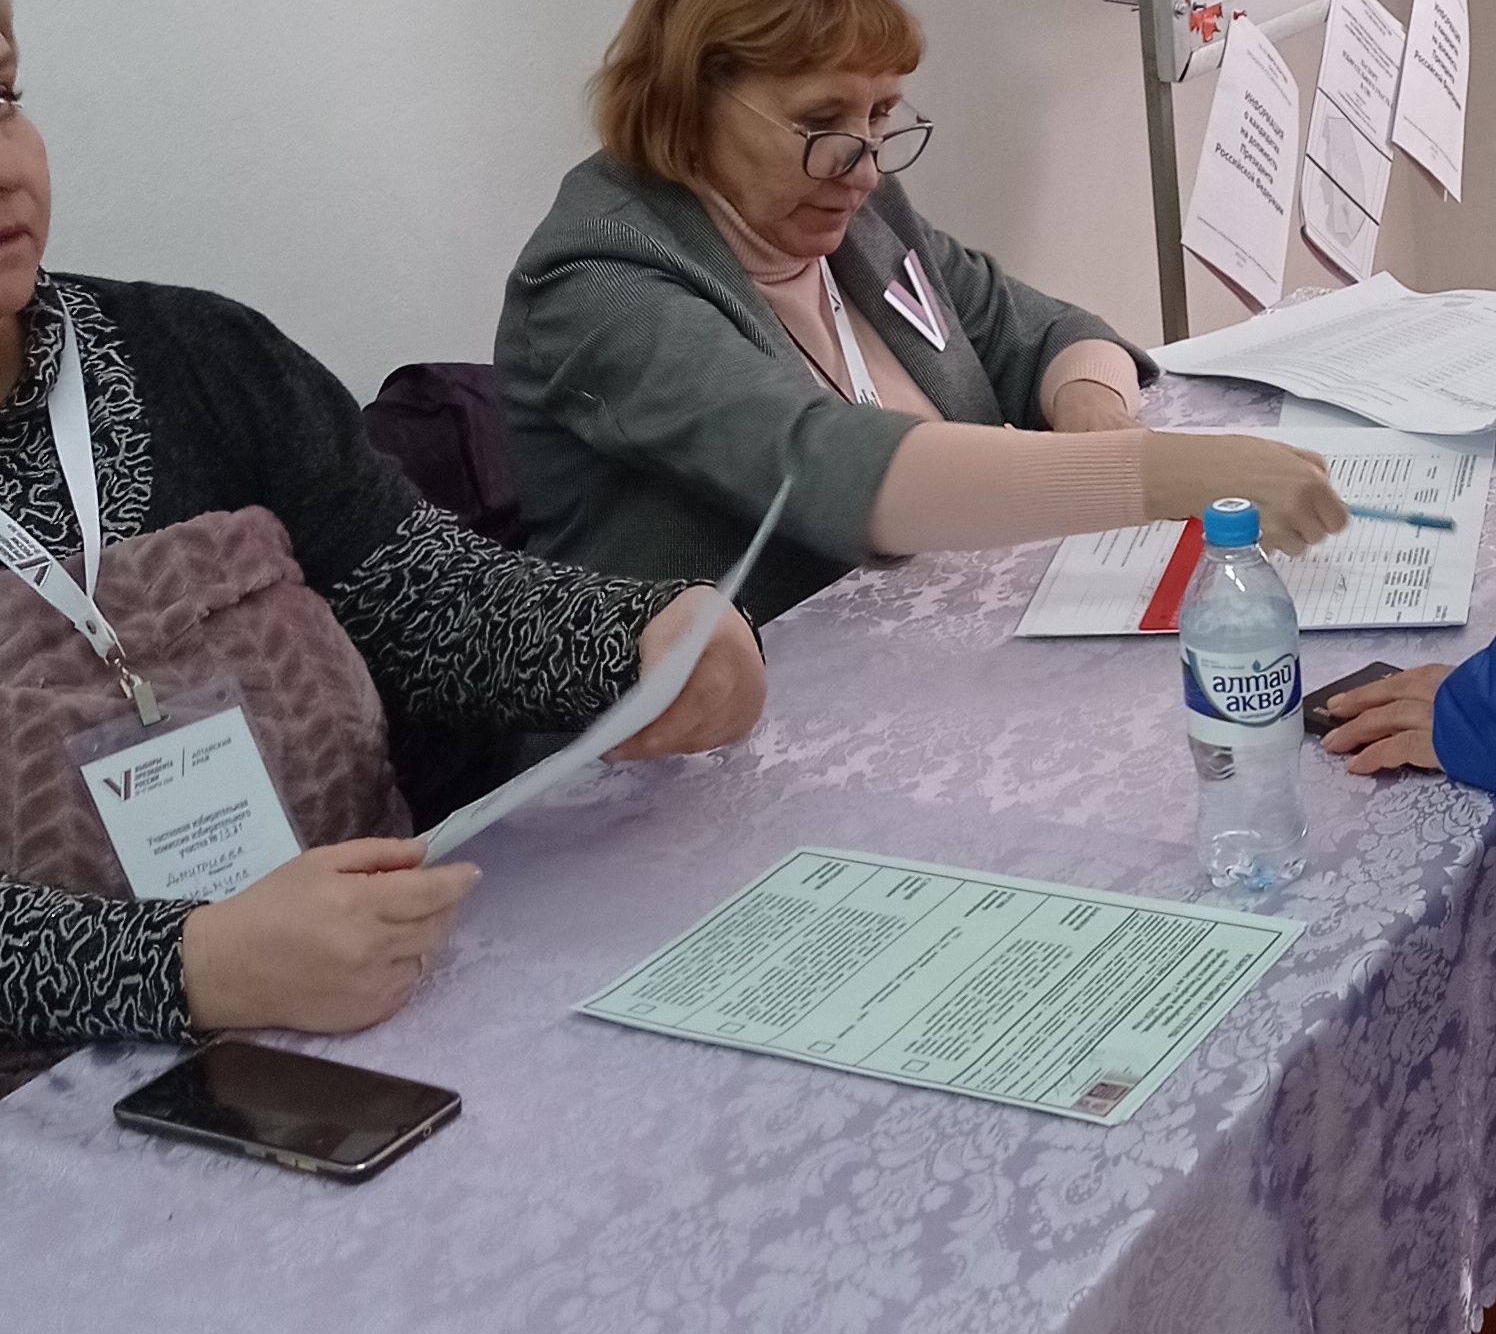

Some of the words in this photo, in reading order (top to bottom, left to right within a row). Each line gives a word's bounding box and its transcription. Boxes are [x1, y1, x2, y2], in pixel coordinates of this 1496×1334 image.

[1215, 142, 1255, 184] Российской
[1212, 664, 1292, 693] алтай
[1226, 688, 1284, 712] аква
